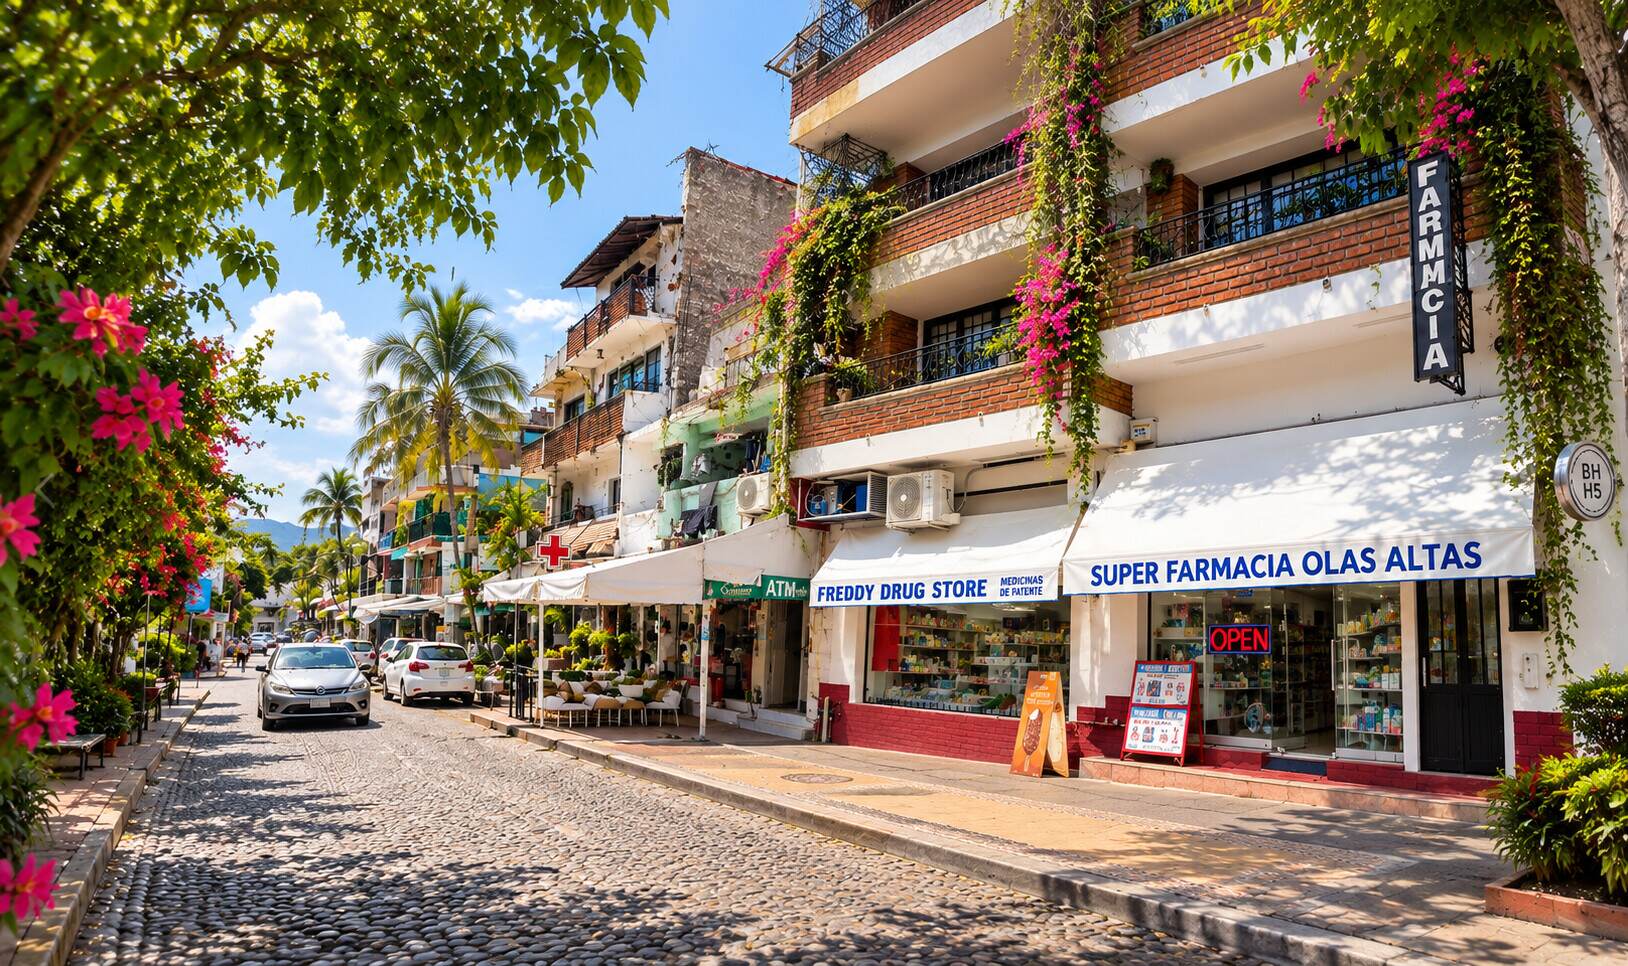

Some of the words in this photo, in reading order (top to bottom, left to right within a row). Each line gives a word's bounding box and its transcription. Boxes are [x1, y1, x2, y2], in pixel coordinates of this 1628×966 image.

[1582, 463, 1601, 480] BH
[1583, 482, 1602, 499] H5
[1090, 562, 1159, 587] SUPER
[1166, 553, 1294, 583] FARMACIA
[1302, 547, 1376, 576] OLAS
[1385, 541, 1483, 572] ALTAS
[766, 579, 796, 597] ATM
[817, 584, 875, 602] FREDDY
[880, 582, 925, 600] DRUG
[932, 579, 988, 598] STORE
[999, 587, 1010, 597] DE
[1210, 627, 1268, 651] OPEN
